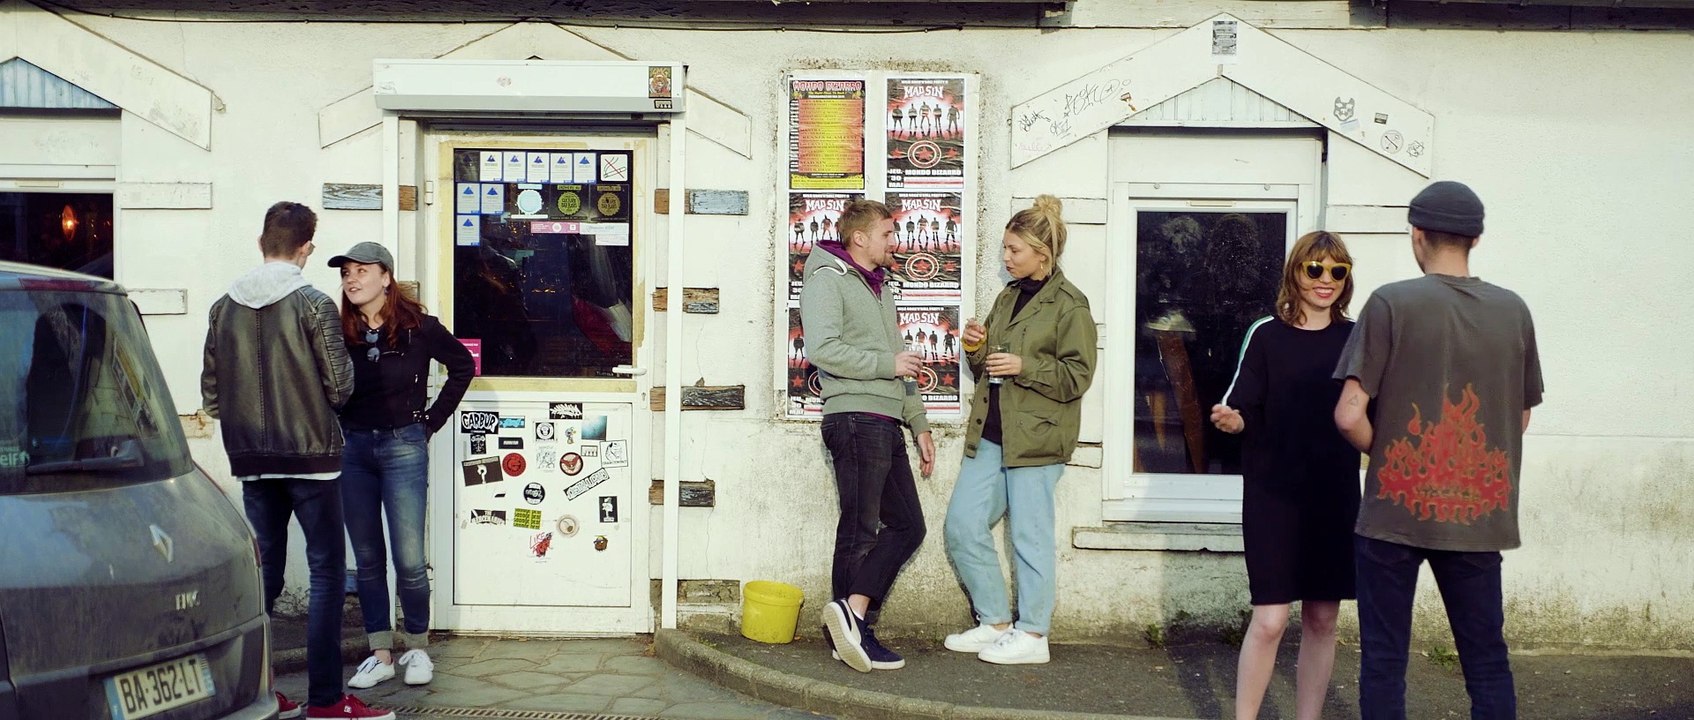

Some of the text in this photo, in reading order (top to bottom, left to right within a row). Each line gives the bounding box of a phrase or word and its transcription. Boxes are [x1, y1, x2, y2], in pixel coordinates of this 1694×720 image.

[793, 81, 862, 91] MONDO BIZARRO
[903, 85, 944, 99] MAD SIN
[804, 199, 846, 212] MAD SIN
[901, 198, 942, 212] MAD SIN
[900, 312, 940, 326] MAD SIN
[0, 452, 18, 467] elf
